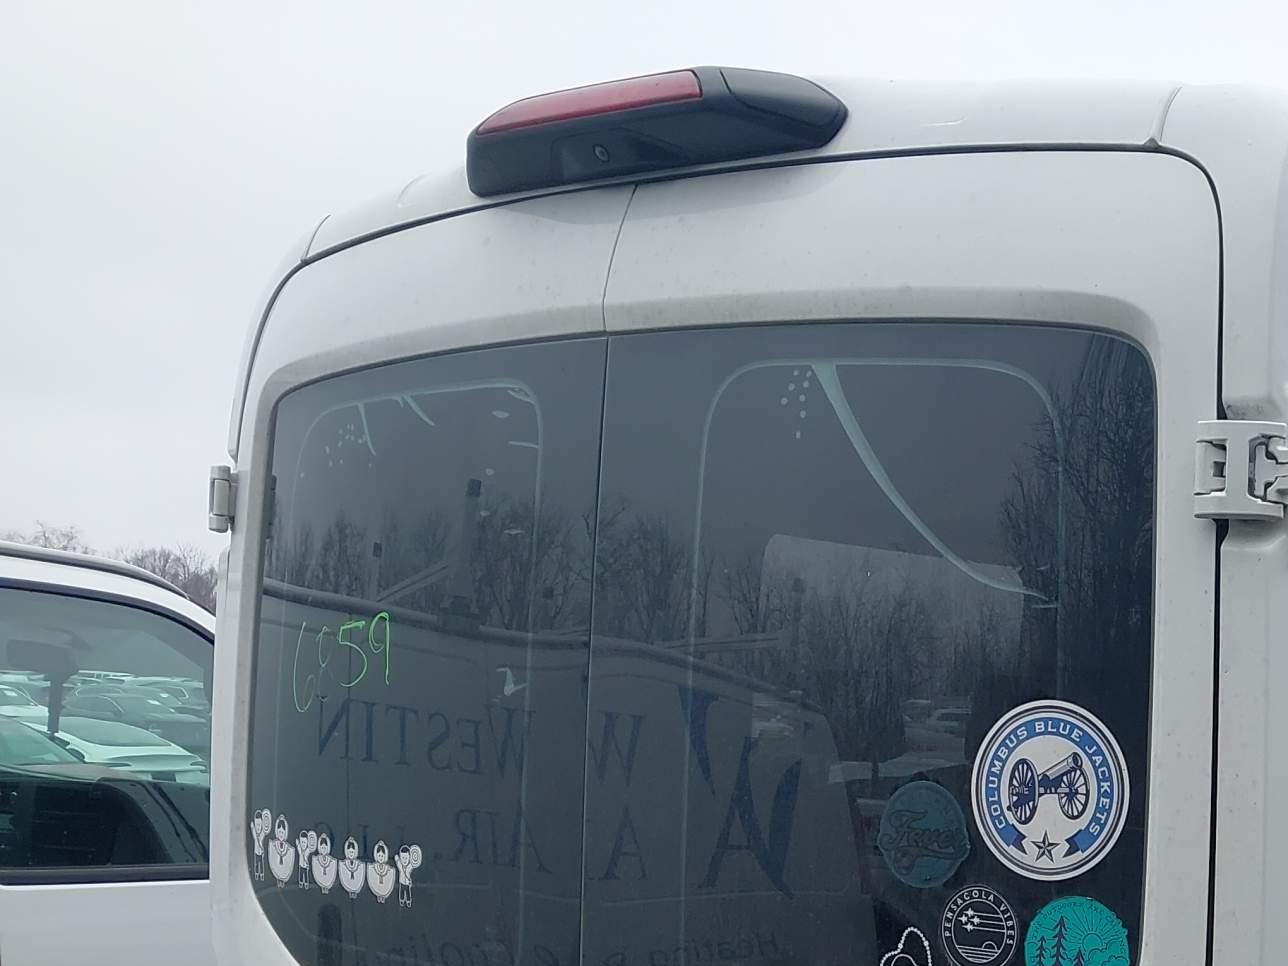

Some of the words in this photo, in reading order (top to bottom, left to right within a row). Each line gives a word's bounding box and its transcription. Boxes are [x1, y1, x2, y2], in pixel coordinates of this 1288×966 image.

[988, 726, 1028, 829] COLUMBUS
[1034, 720, 1083, 742] BLUE
[1085, 744, 1111, 837] JACKETS
[944, 890, 995, 937] PENSACOLA
[1000, 903, 1015, 945] VIBES
